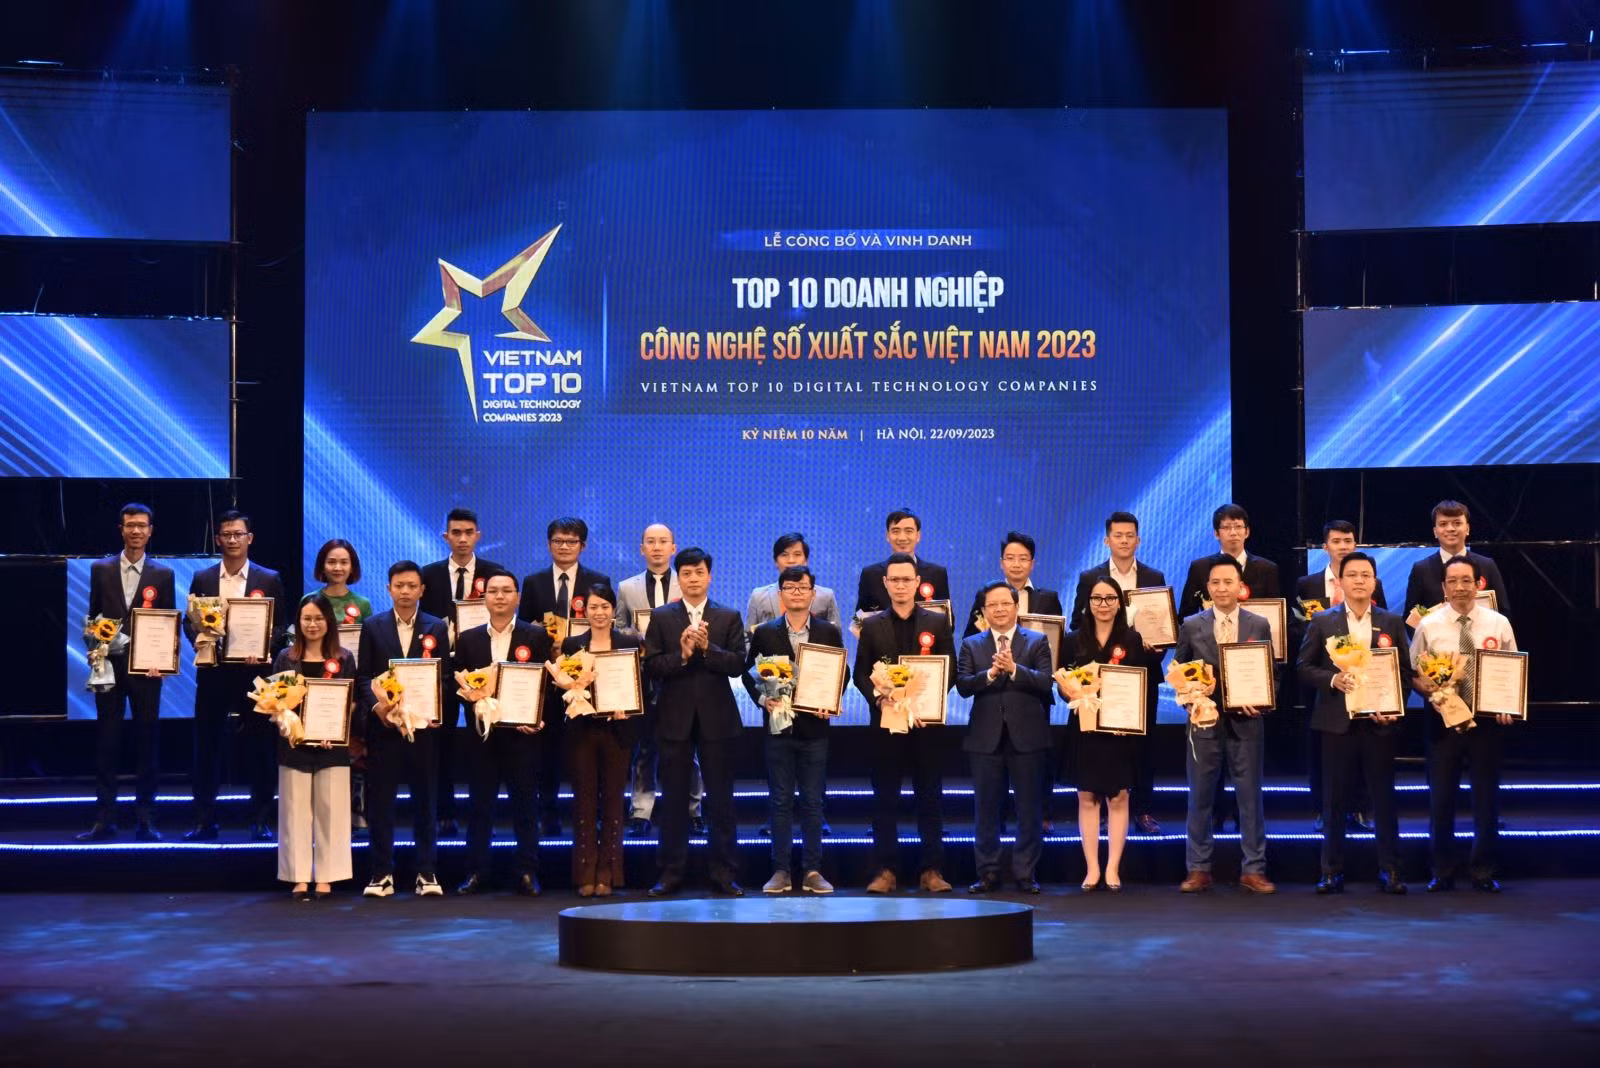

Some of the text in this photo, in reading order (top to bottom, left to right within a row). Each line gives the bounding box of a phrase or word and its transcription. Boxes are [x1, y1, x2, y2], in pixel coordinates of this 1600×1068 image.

[764, 231, 973, 247] LỄ CÔNG BỐ VÀ VINH DANH
[732, 270, 1005, 313] TOP 10 DOANH NGHIỆP
[640, 320, 1096, 365] CÔNG NGHỆ SỐ XUẤT SẮC VIỆT NAM 2023
[483, 350, 582, 366] VIETNAM
[483, 372, 582, 394] TOP 10
[640, 380, 1098, 393] VIETNAM TOP 10 DIGITAL TECHNOLOGY COMPANIES
[482, 399, 582, 409] DIGITAL TECHNOLOGY
[482, 412, 563, 423] COMPANIES 2023
[762, 427, 798, 441] NIỆM
[801, 429, 815, 440] 10
[818, 427, 849, 440] NĂM
[876, 427, 896, 440] HÀ
[929, 428, 995, 440] 22/09/2023
